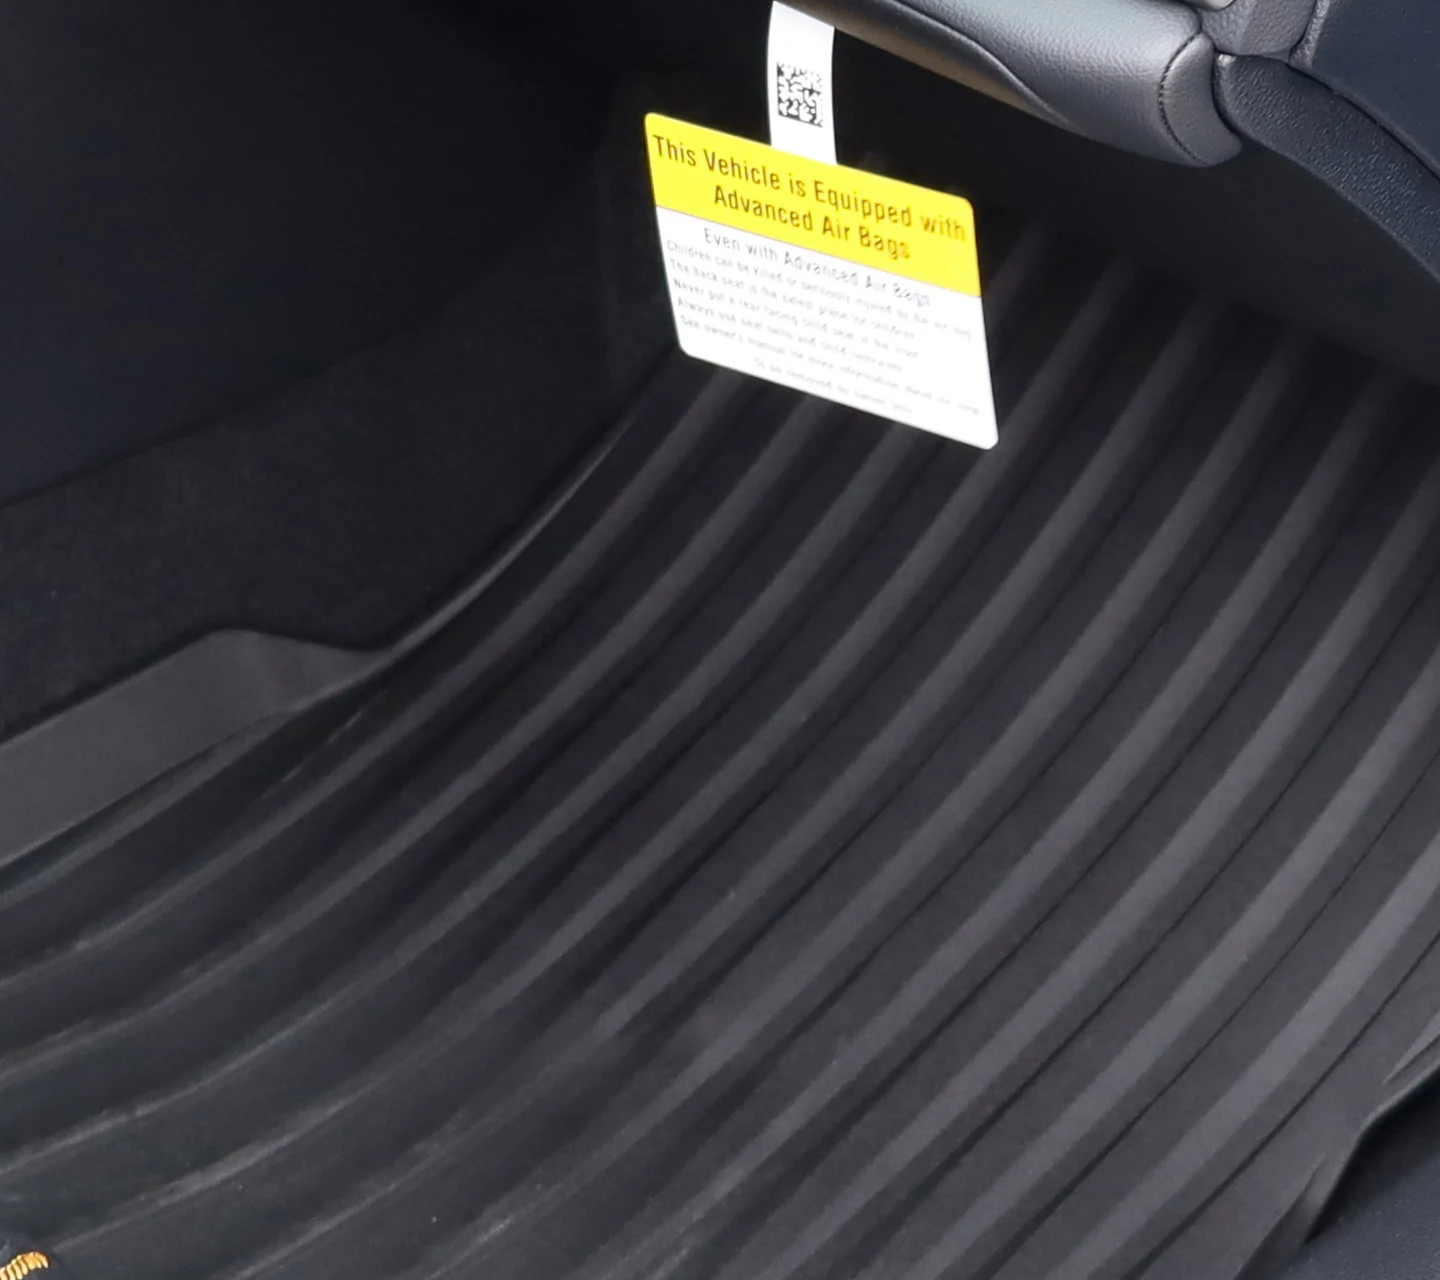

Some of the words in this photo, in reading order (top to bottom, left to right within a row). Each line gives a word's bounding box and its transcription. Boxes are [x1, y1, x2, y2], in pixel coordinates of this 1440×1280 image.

[653, 134, 697, 167] This
[703, 148, 781, 191] Vehicle
[788, 172, 807, 198] is
[813, 179, 912, 227] Equipped
[920, 214, 966, 243] with
[714, 184, 814, 232] Advanced
[822, 215, 851, 242] Air
[858, 225, 911, 261] Bags
[704, 227, 741, 252] Even
[746, 241, 778, 263] with
[784, 250, 859, 286] Advanced
